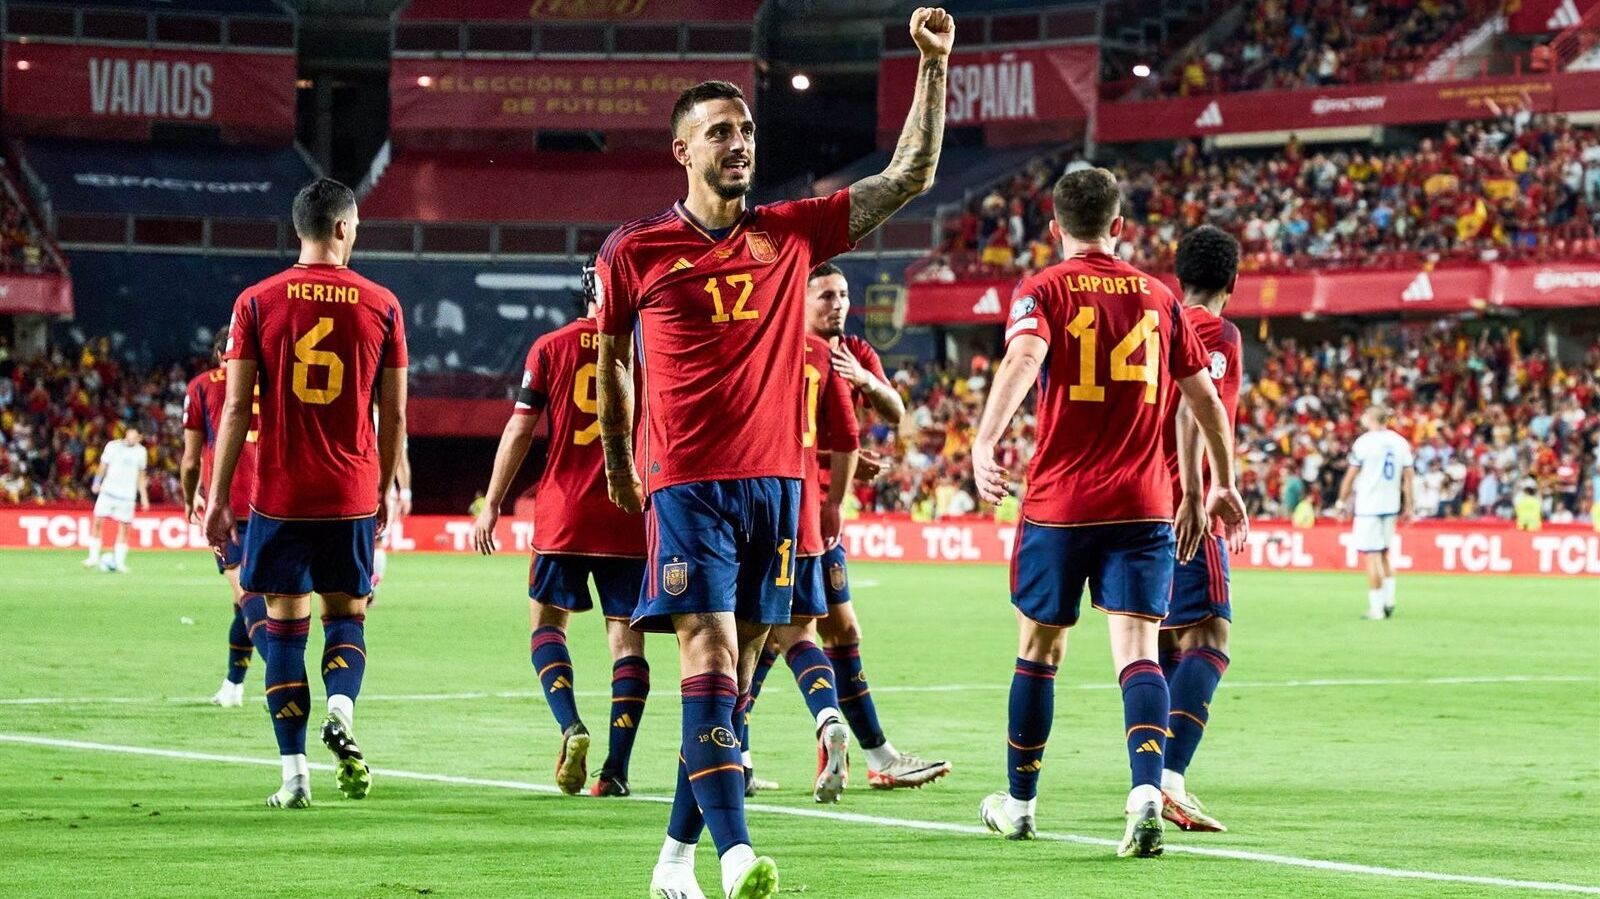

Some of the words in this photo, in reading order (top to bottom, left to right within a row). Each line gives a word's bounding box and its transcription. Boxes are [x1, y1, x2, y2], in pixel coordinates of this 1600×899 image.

[89, 57, 213, 118] VAMOS
[946, 53, 1035, 121] SPAÑA
[287, 283, 359, 304] MERINO
[704, 273, 759, 323] 12
[1066, 275, 1151, 295] LAPORTE
[292, 317, 344, 404] 6
[1066, 306, 1160, 404] 14
[1384, 451, 1395, 480] 6
[18, 515, 100, 547] TCL
[845, 524, 904, 558] TCL
[922, 526, 981, 559] TCL
[1247, 530, 1313, 567] TCL
[1338, 532, 1412, 568] TL
[1435, 533, 1512, 571] TCL
[1532, 535, 1600, 574] TCL
[775, 539, 795, 586] 1
